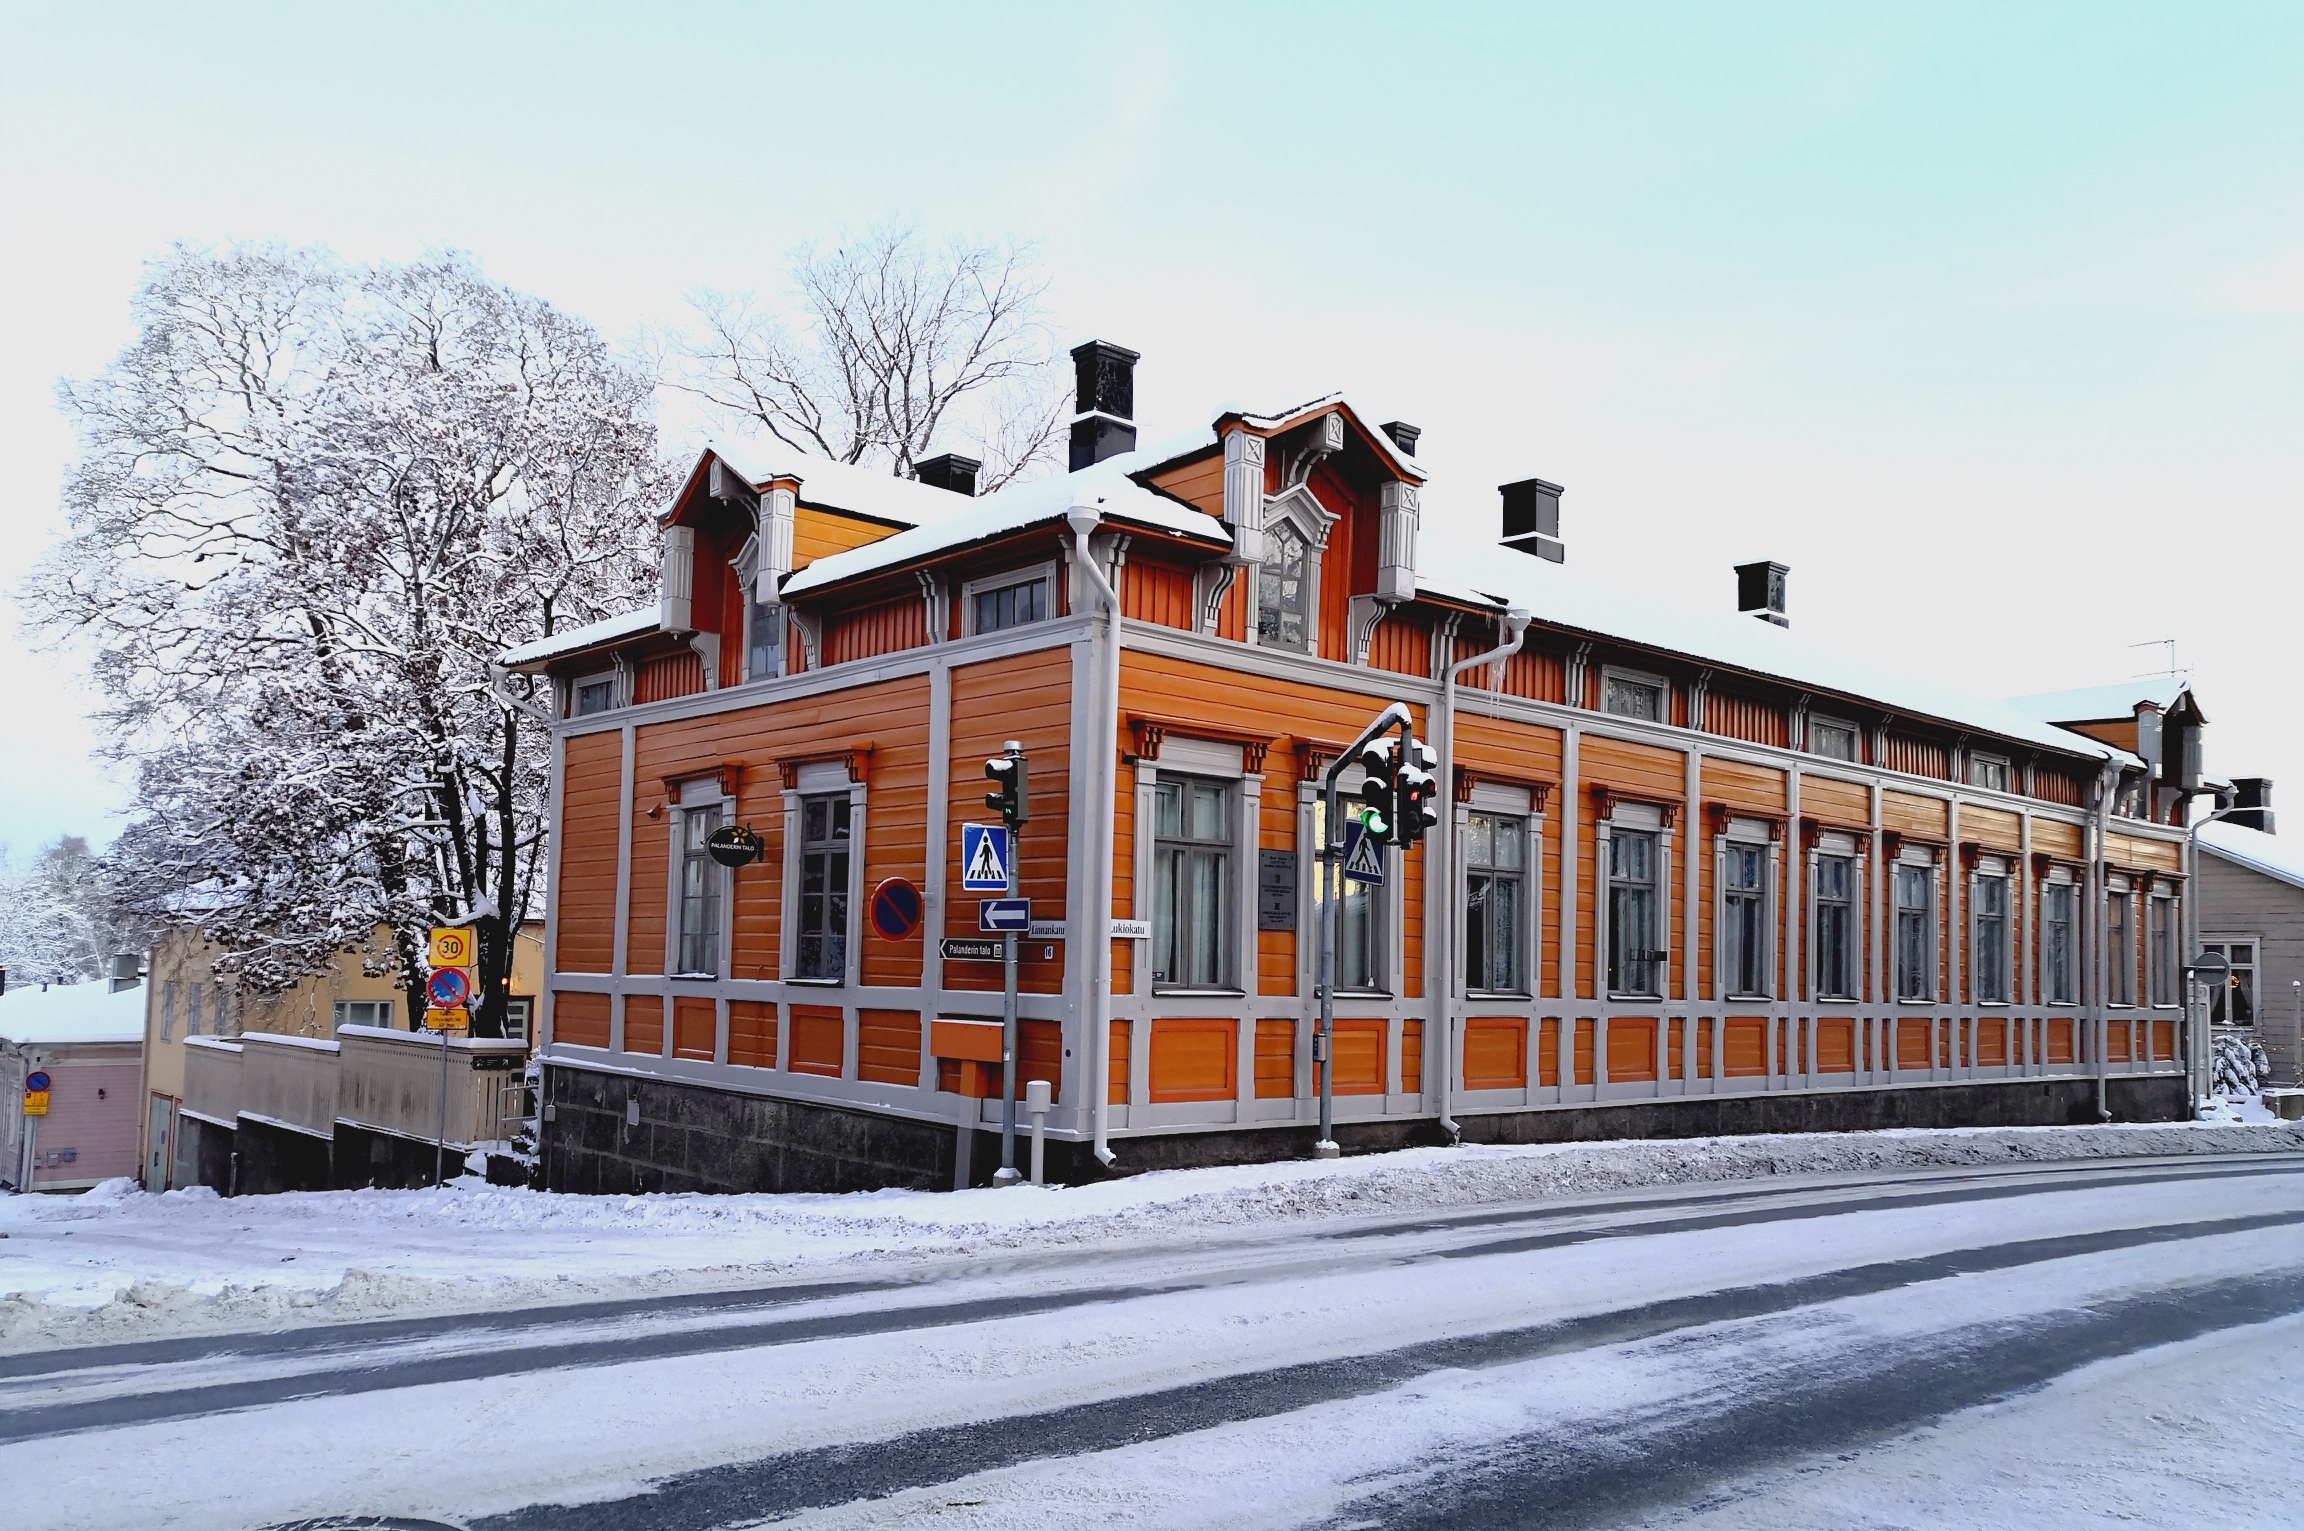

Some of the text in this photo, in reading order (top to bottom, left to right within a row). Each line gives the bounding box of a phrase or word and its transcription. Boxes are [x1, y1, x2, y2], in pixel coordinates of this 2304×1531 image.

[1031, 924, 1065, 935] Linnankatu
[442, 941, 459, 954] 30
[949, 944, 991, 956] Palanderin talo
